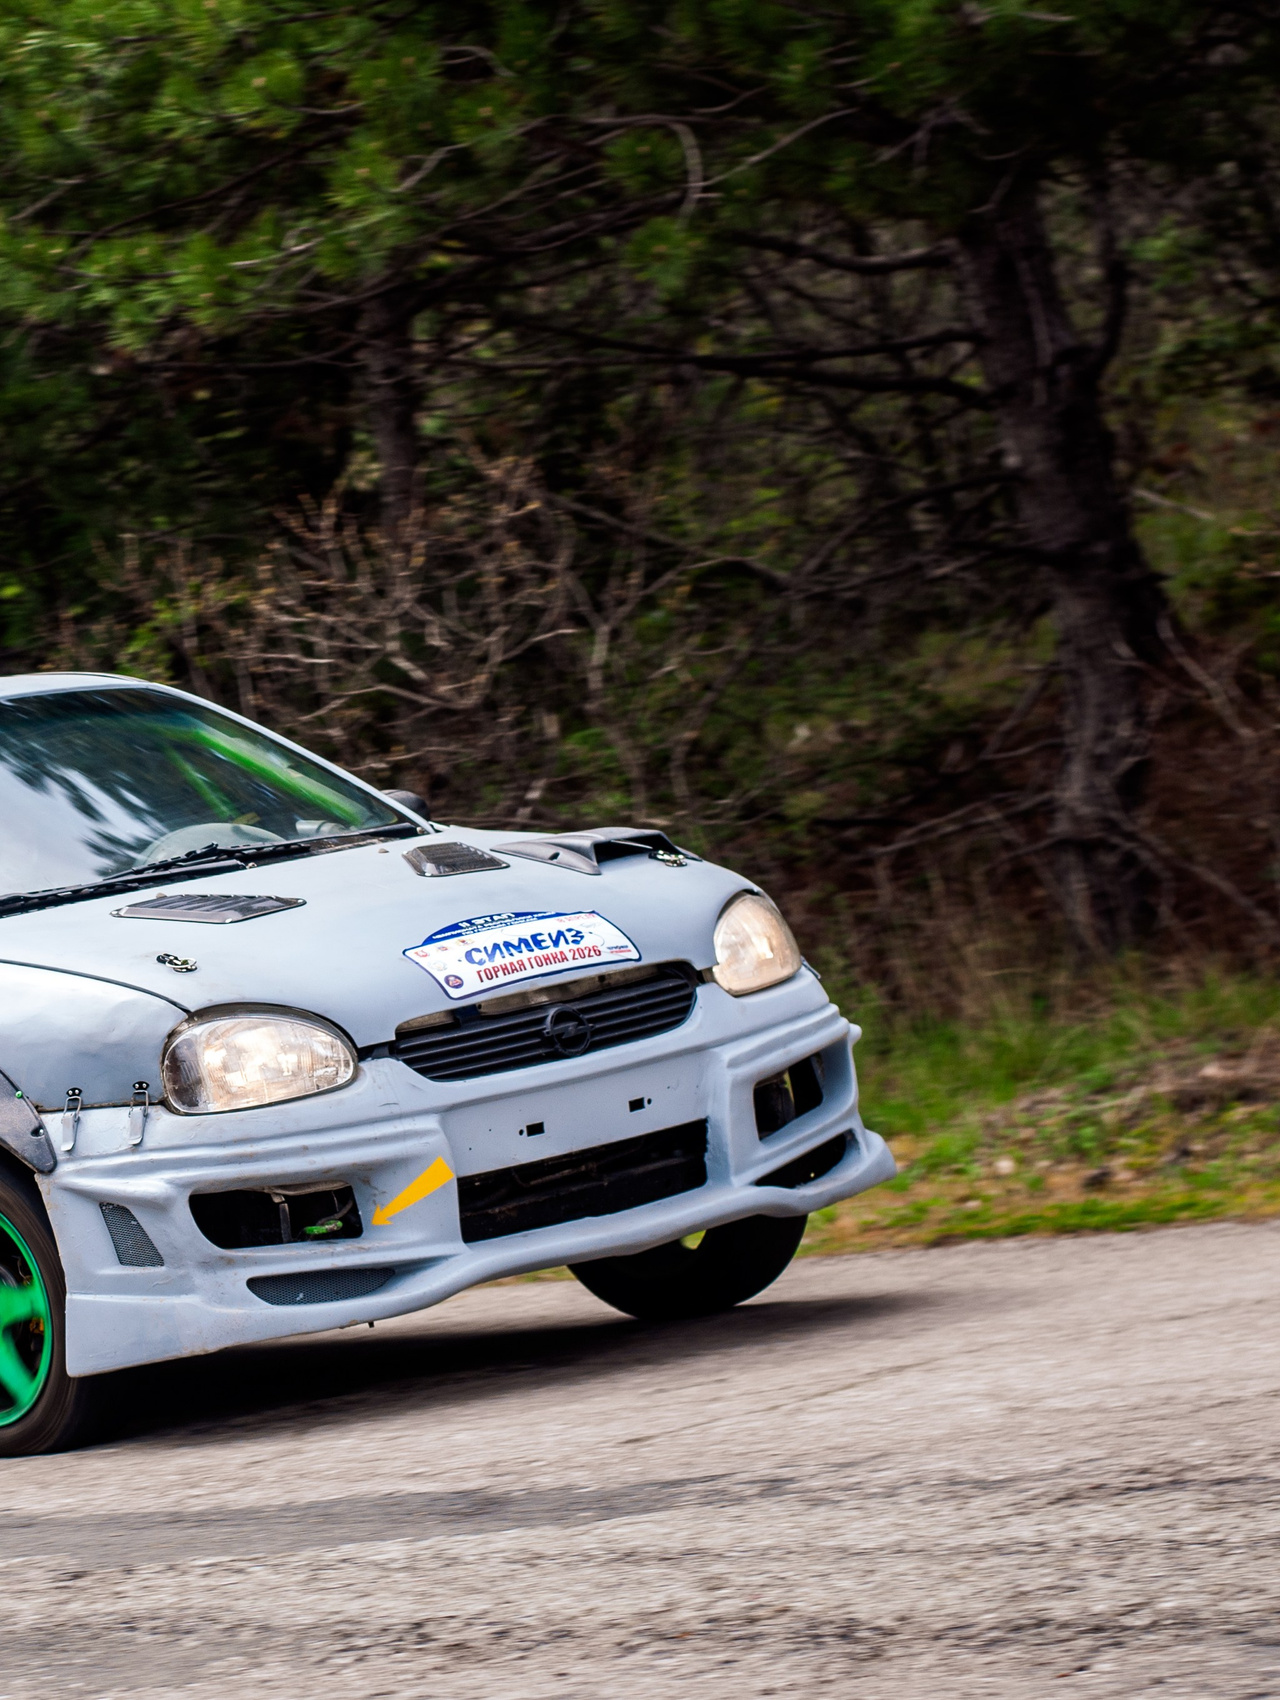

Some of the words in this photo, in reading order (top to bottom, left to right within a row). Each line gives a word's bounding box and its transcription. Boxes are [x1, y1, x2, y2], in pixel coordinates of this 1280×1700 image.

[471, 912, 515, 925] ЭТАП
[464, 928, 585, 966] СИМЕИЗ
[476, 958, 527, 983] ГОРНАЯ
[528, 951, 568, 970] ГОНКА
[569, 945, 601, 961] 2026
